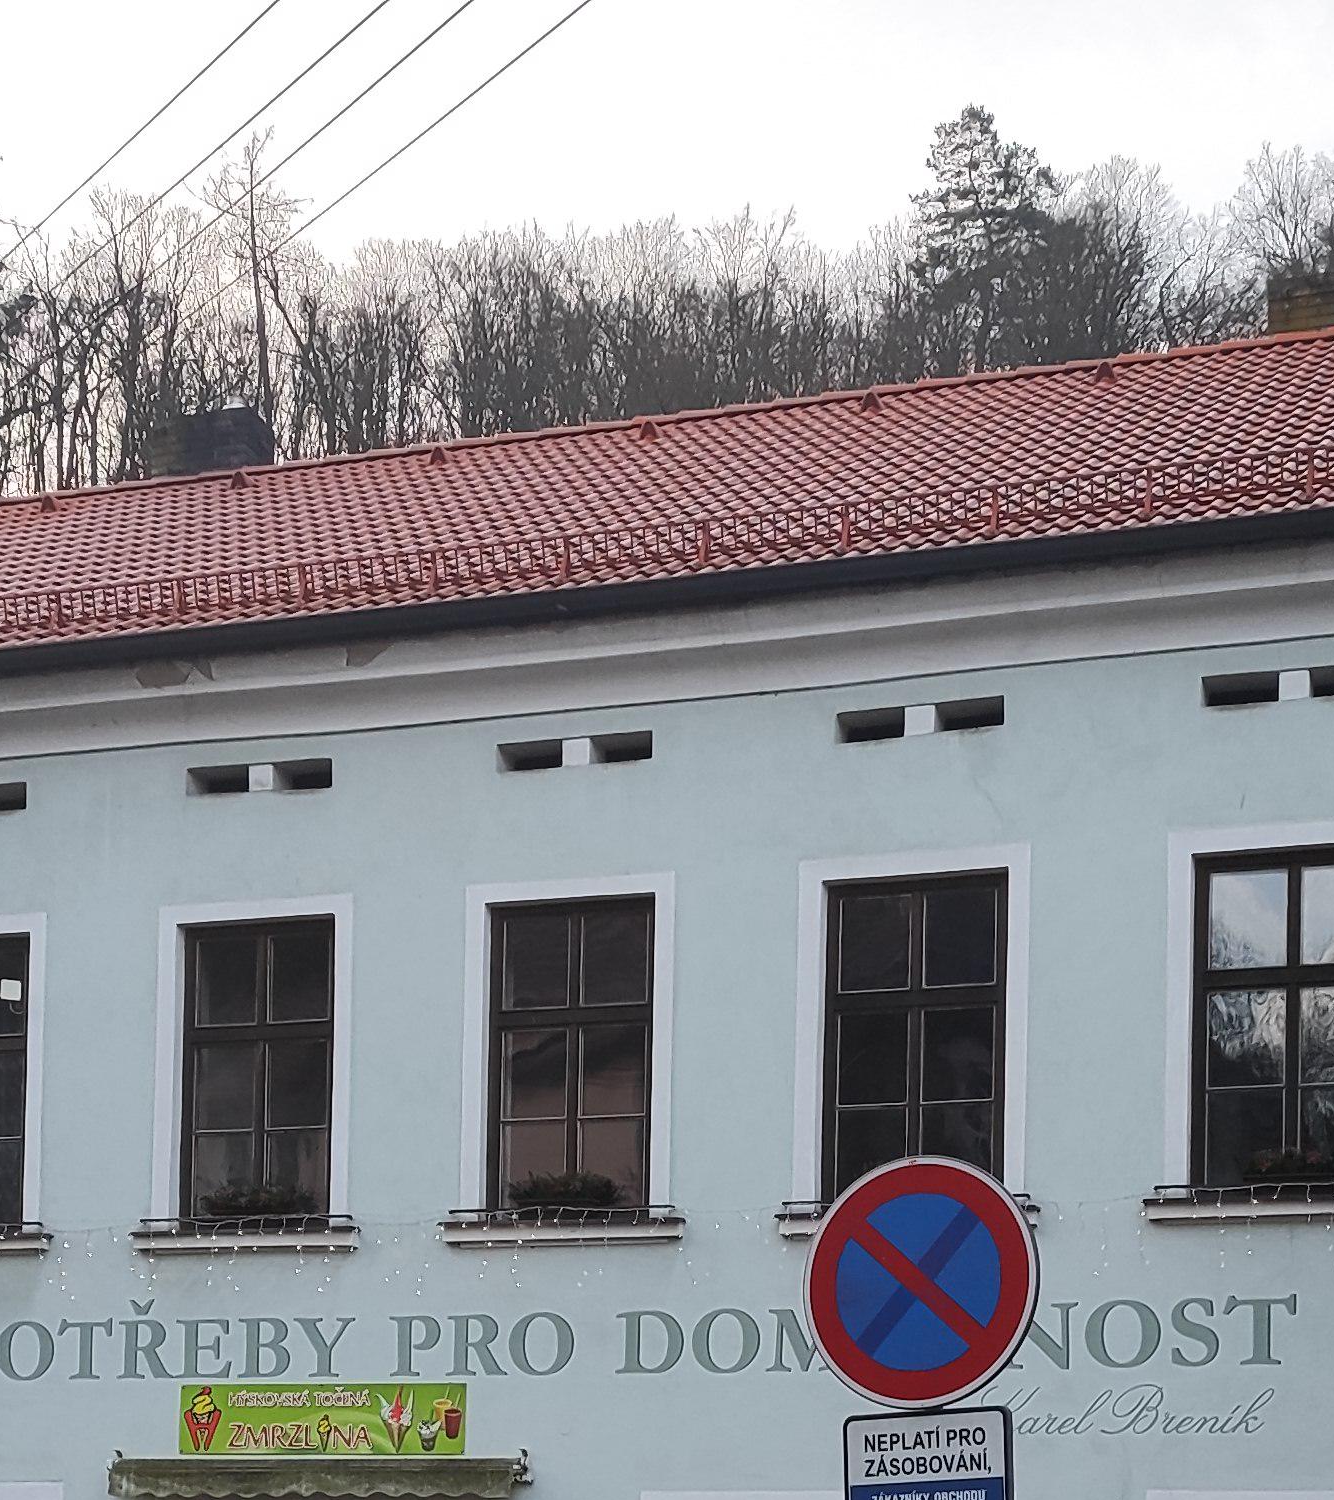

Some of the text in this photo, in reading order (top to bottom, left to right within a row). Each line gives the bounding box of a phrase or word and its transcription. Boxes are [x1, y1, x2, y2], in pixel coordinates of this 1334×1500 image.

[389, 1311, 574, 1377] PRO
[614, 1293, 1297, 1375] DOMNOST
[1100, 1383, 1275, 1436] Breník
[864, 1425, 986, 1453] NEPLATÍ PRO
[864, 1448, 992, 1478] ZÁSOBOVÁNÍ,
